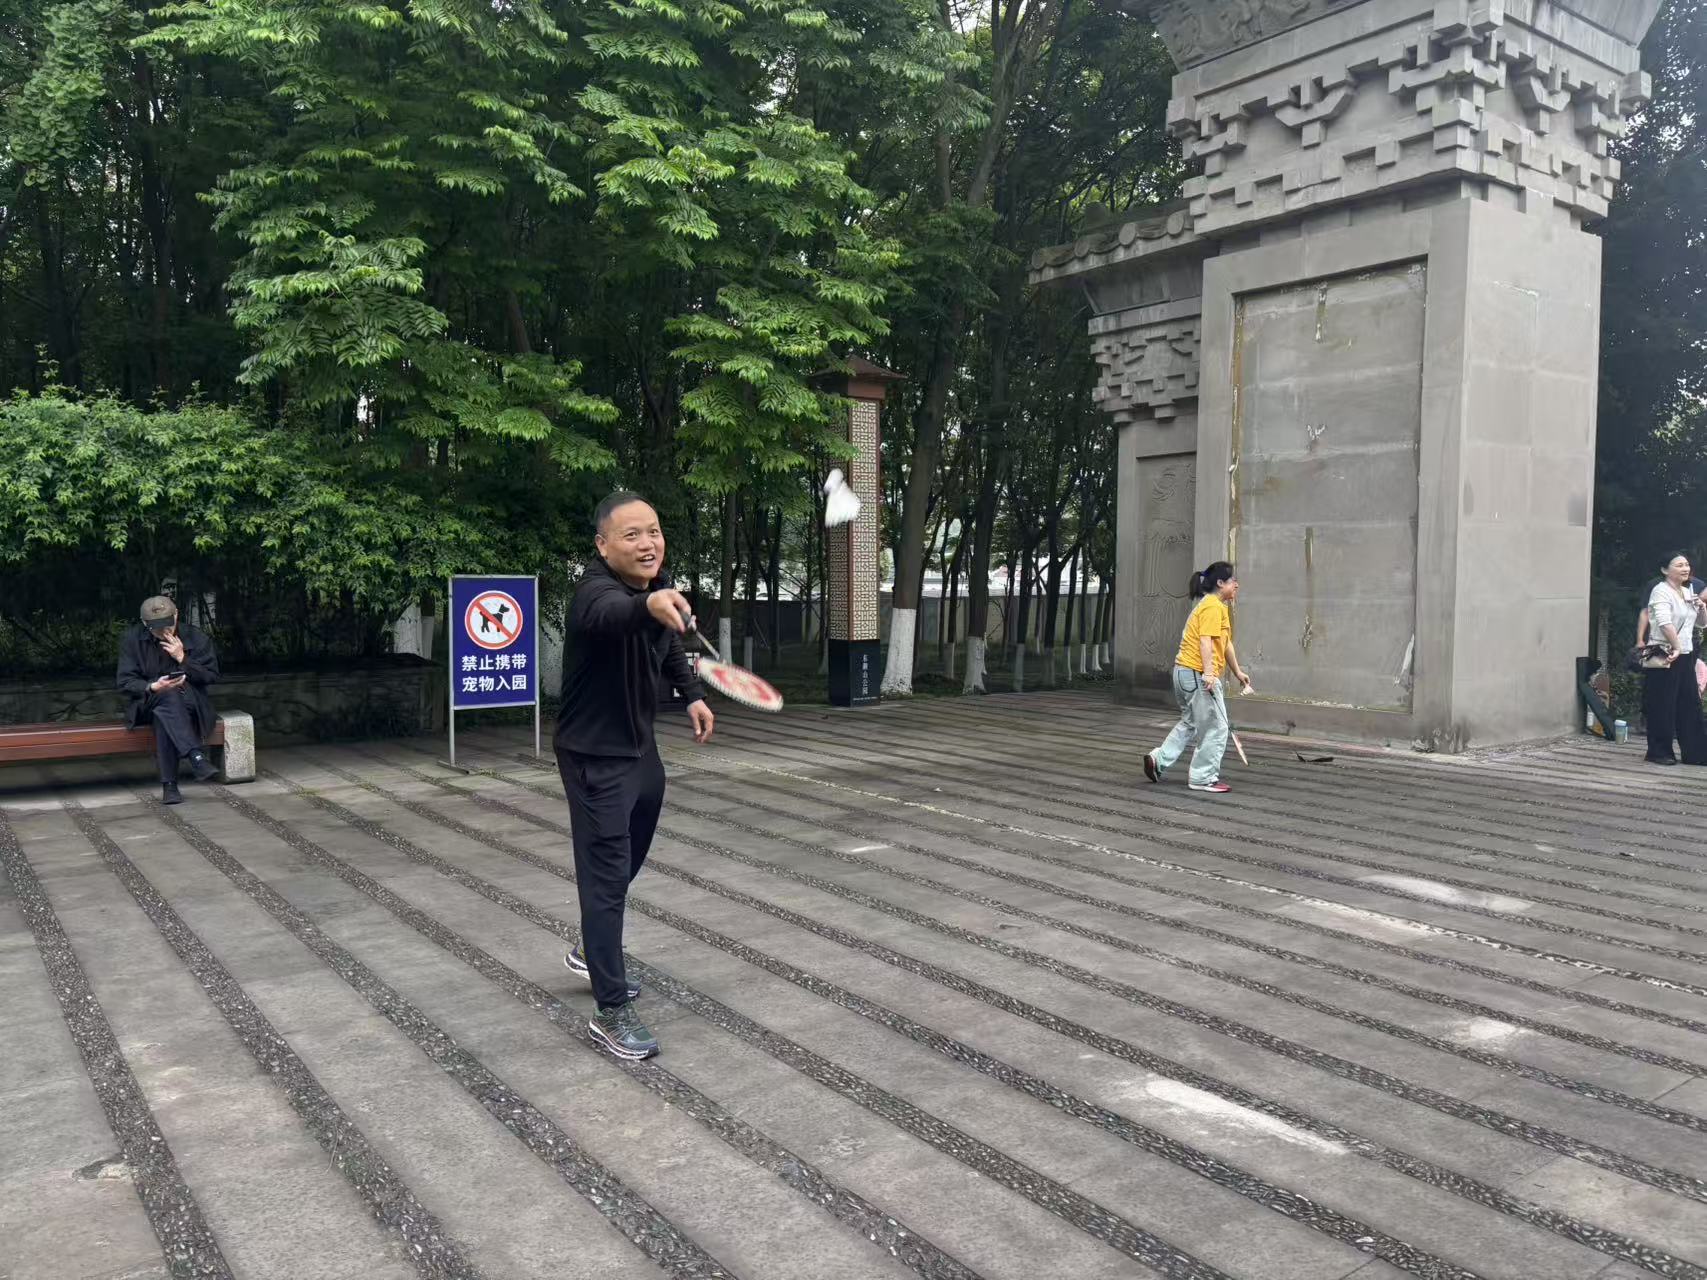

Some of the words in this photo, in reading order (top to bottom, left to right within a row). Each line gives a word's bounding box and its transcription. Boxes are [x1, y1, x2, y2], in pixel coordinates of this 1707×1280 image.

[461, 653, 527, 672] 禁止携带
[462, 674, 527, 692] 宠物入园
